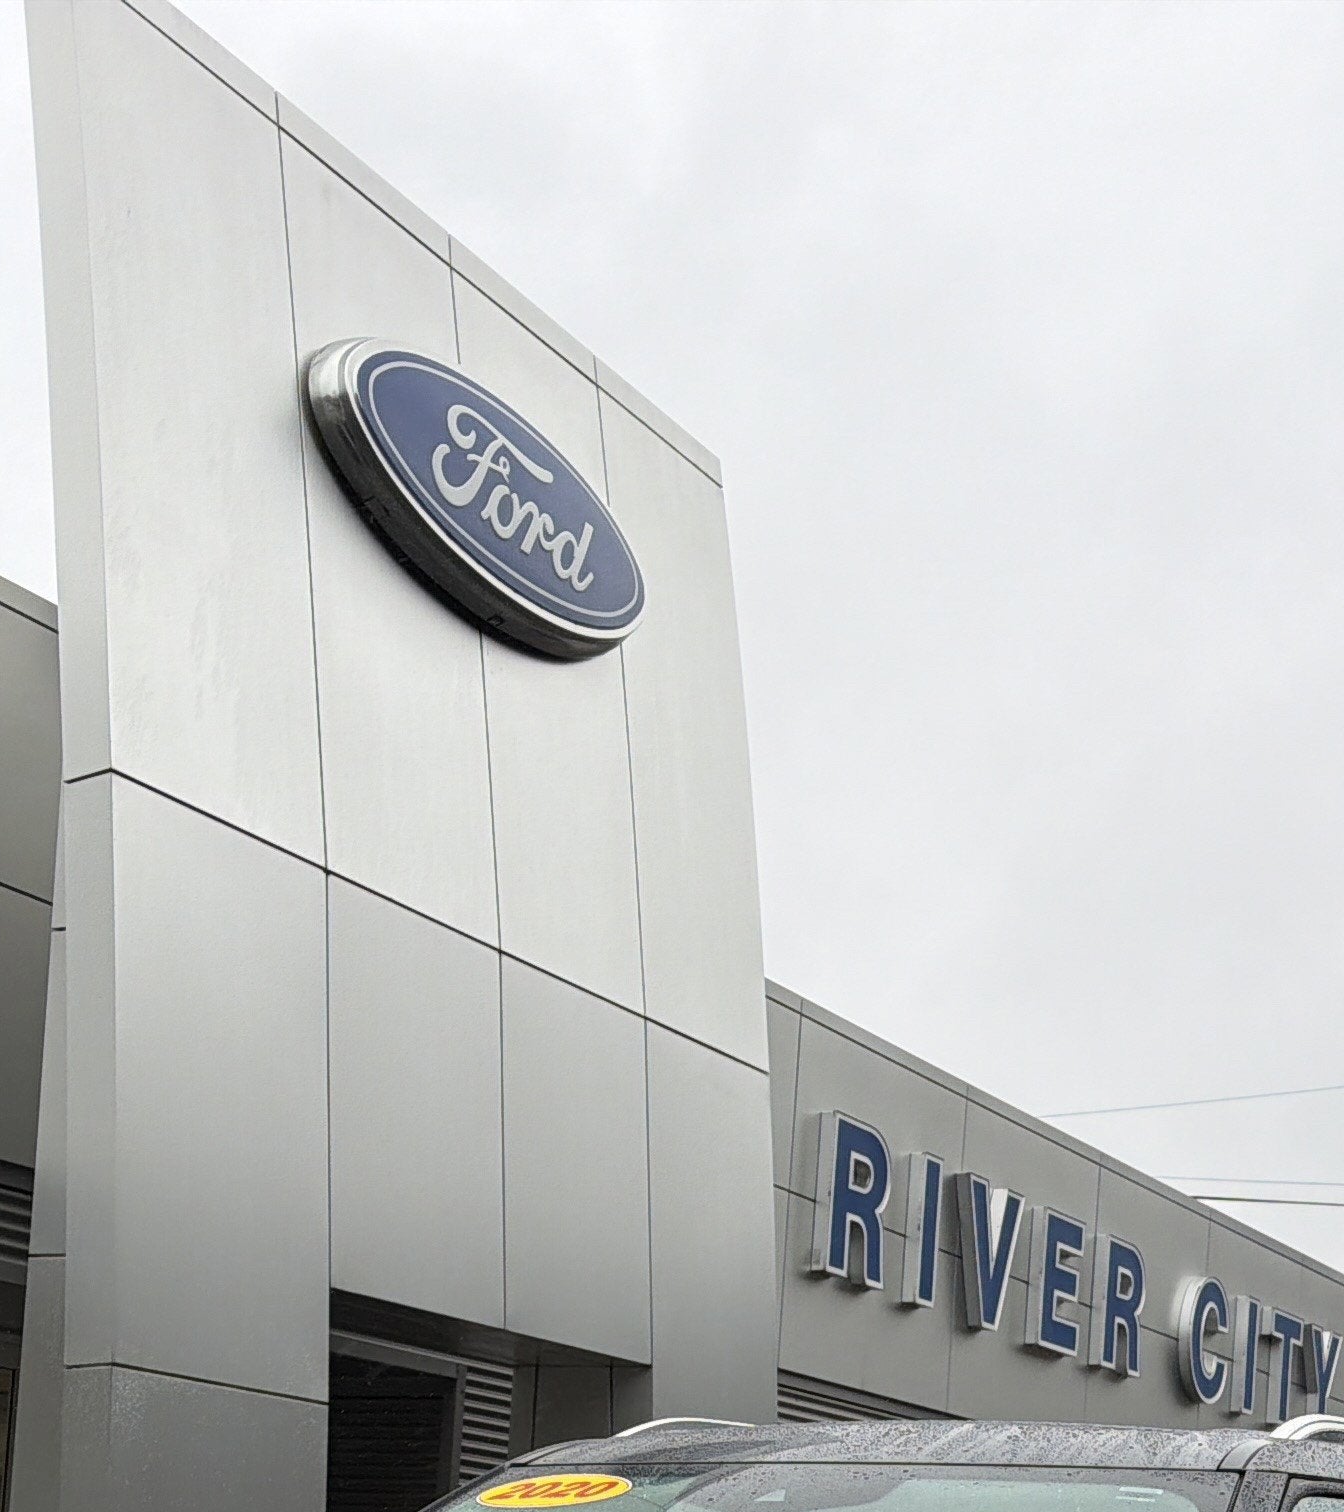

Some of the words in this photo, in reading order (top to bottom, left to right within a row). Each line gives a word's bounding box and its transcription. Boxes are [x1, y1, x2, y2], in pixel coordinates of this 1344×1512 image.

[432, 404, 594, 591] Ford
[813, 1110, 1147, 1378] RIVER
[1179, 1276, 1344, 1425] CITY
[488, 1481, 619, 1500] 2020
